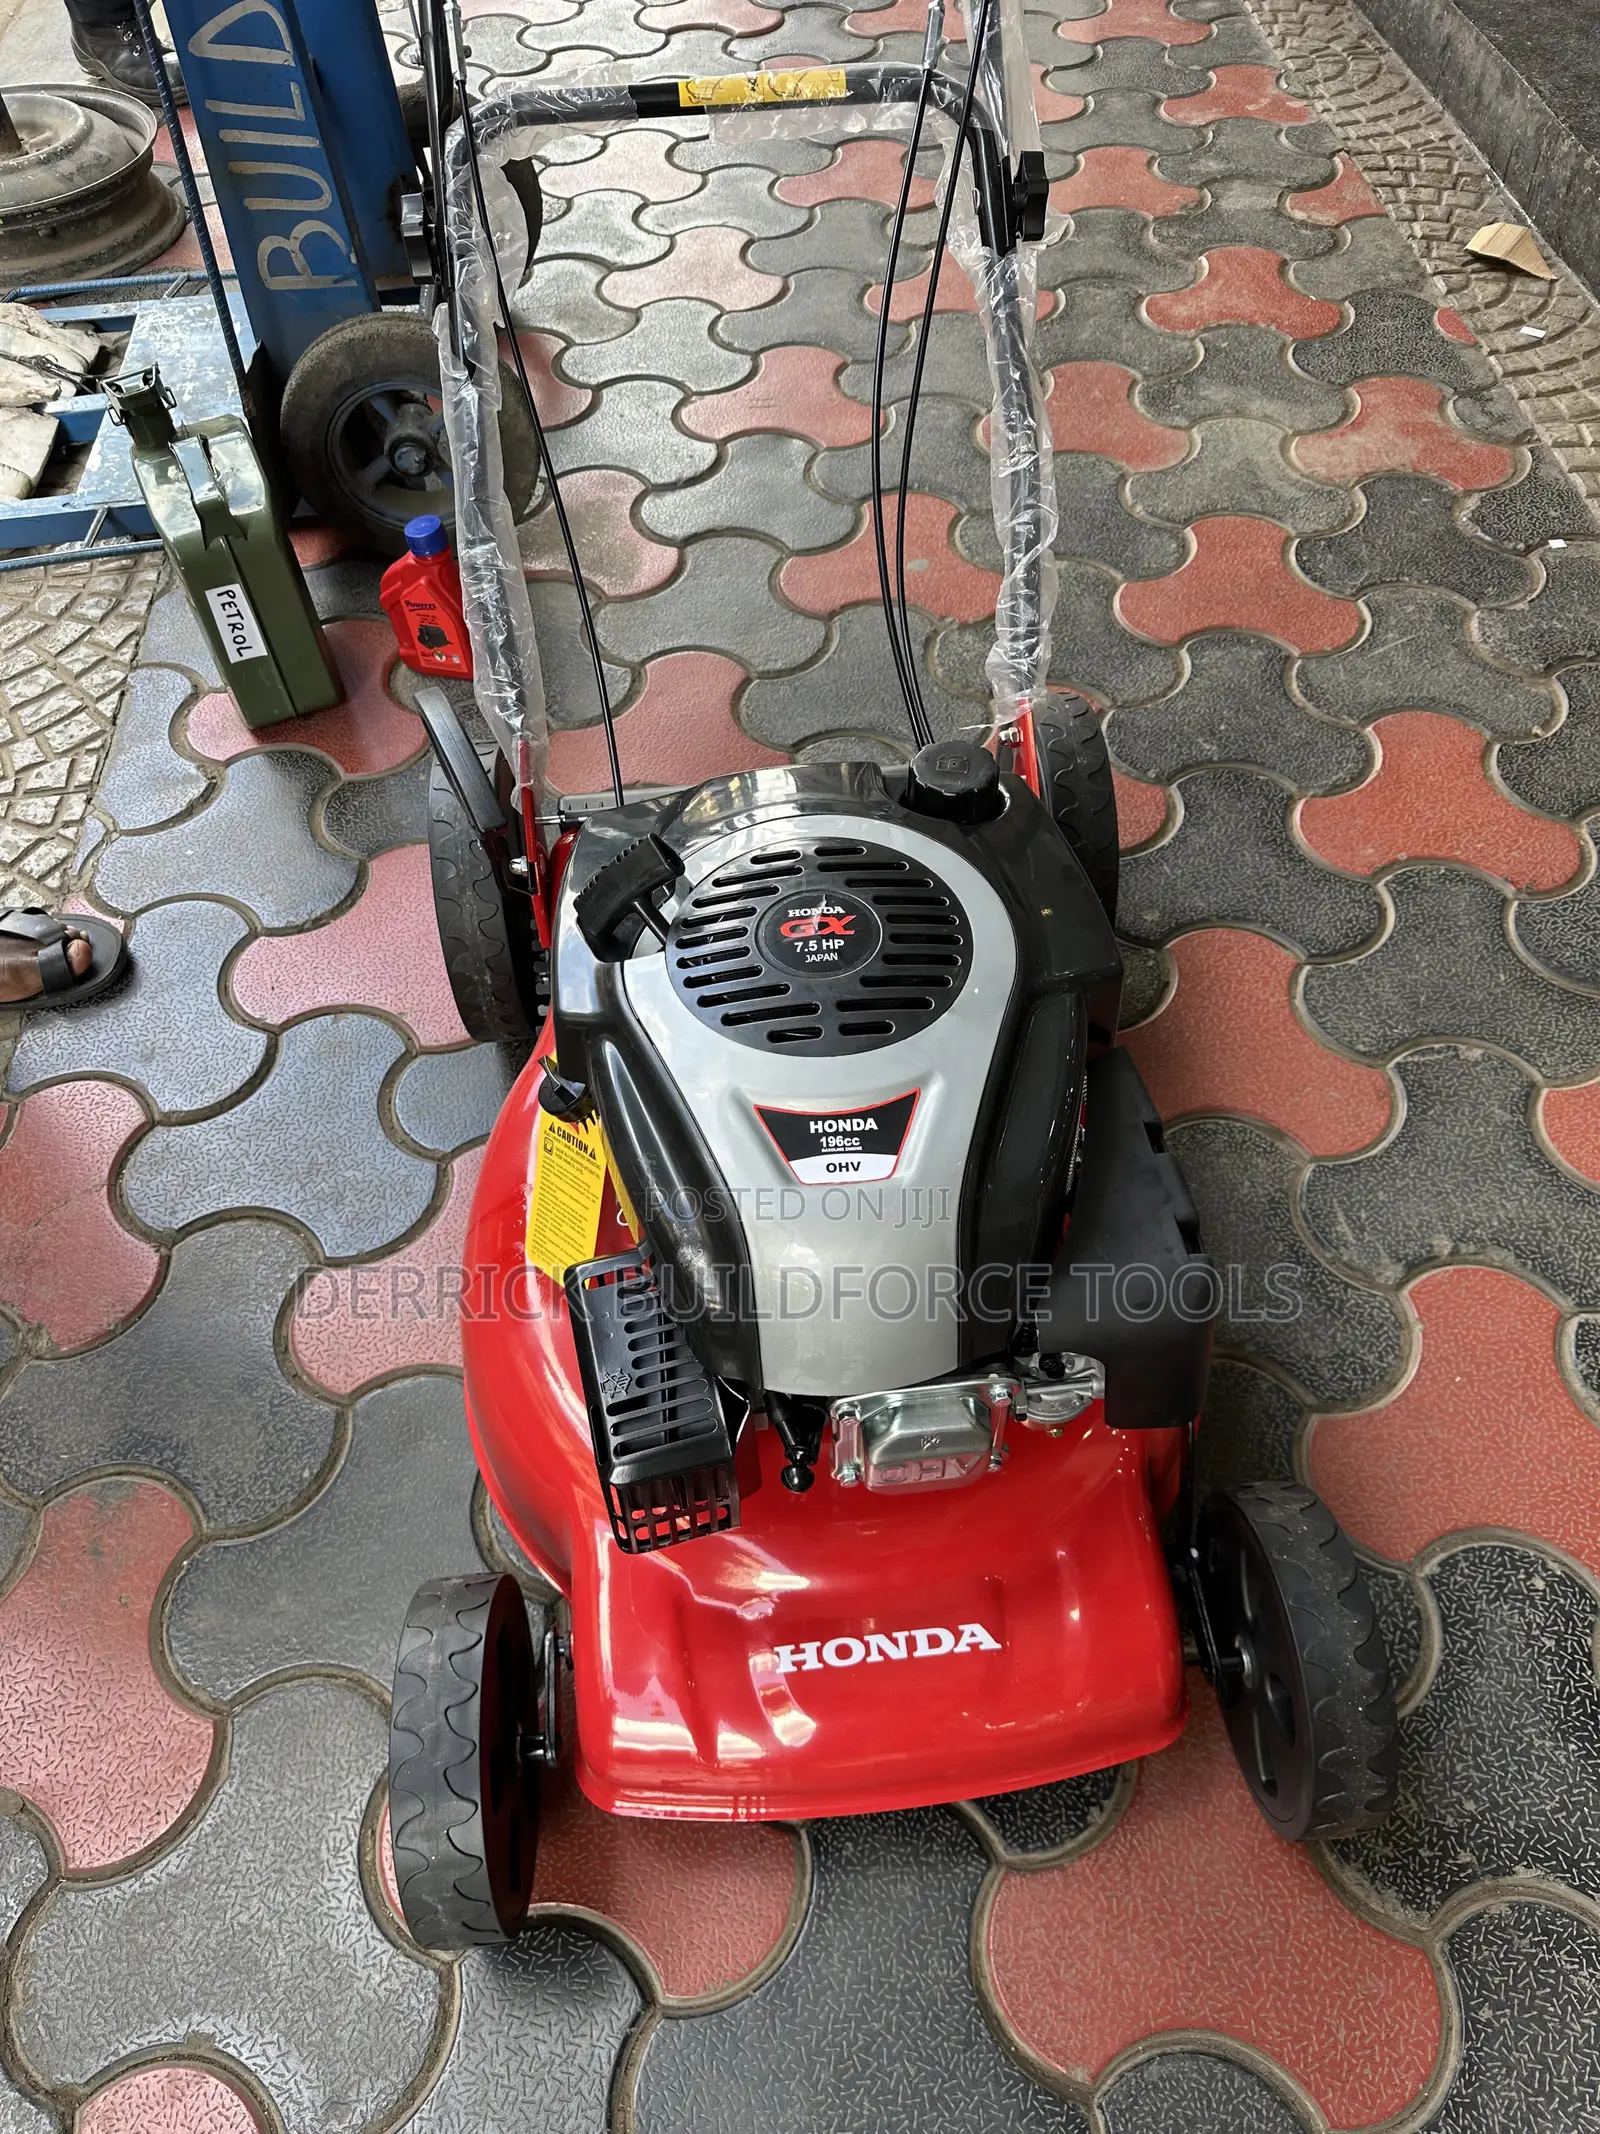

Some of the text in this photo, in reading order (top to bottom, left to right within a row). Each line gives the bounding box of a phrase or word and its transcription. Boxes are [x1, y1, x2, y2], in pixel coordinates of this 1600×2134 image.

[188, 0, 358, 290] BUILD
[217, 589, 253, 657] PETROL
[787, 906, 845, 918] HONDA
[779, 914, 857, 938] GX
[794, 939, 845, 953] 7.5 HP
[805, 952, 838, 963] JAPAN
[809, 1118, 878, 1134] HONDA
[556, 1126, 589, 1155] CAUTION
[820, 1135, 860, 1148] 196cc
[826, 1161, 861, 1173] OHV
[881, 1455, 980, 1484] OHV
[774, 1623, 1002, 1674] HONDA
